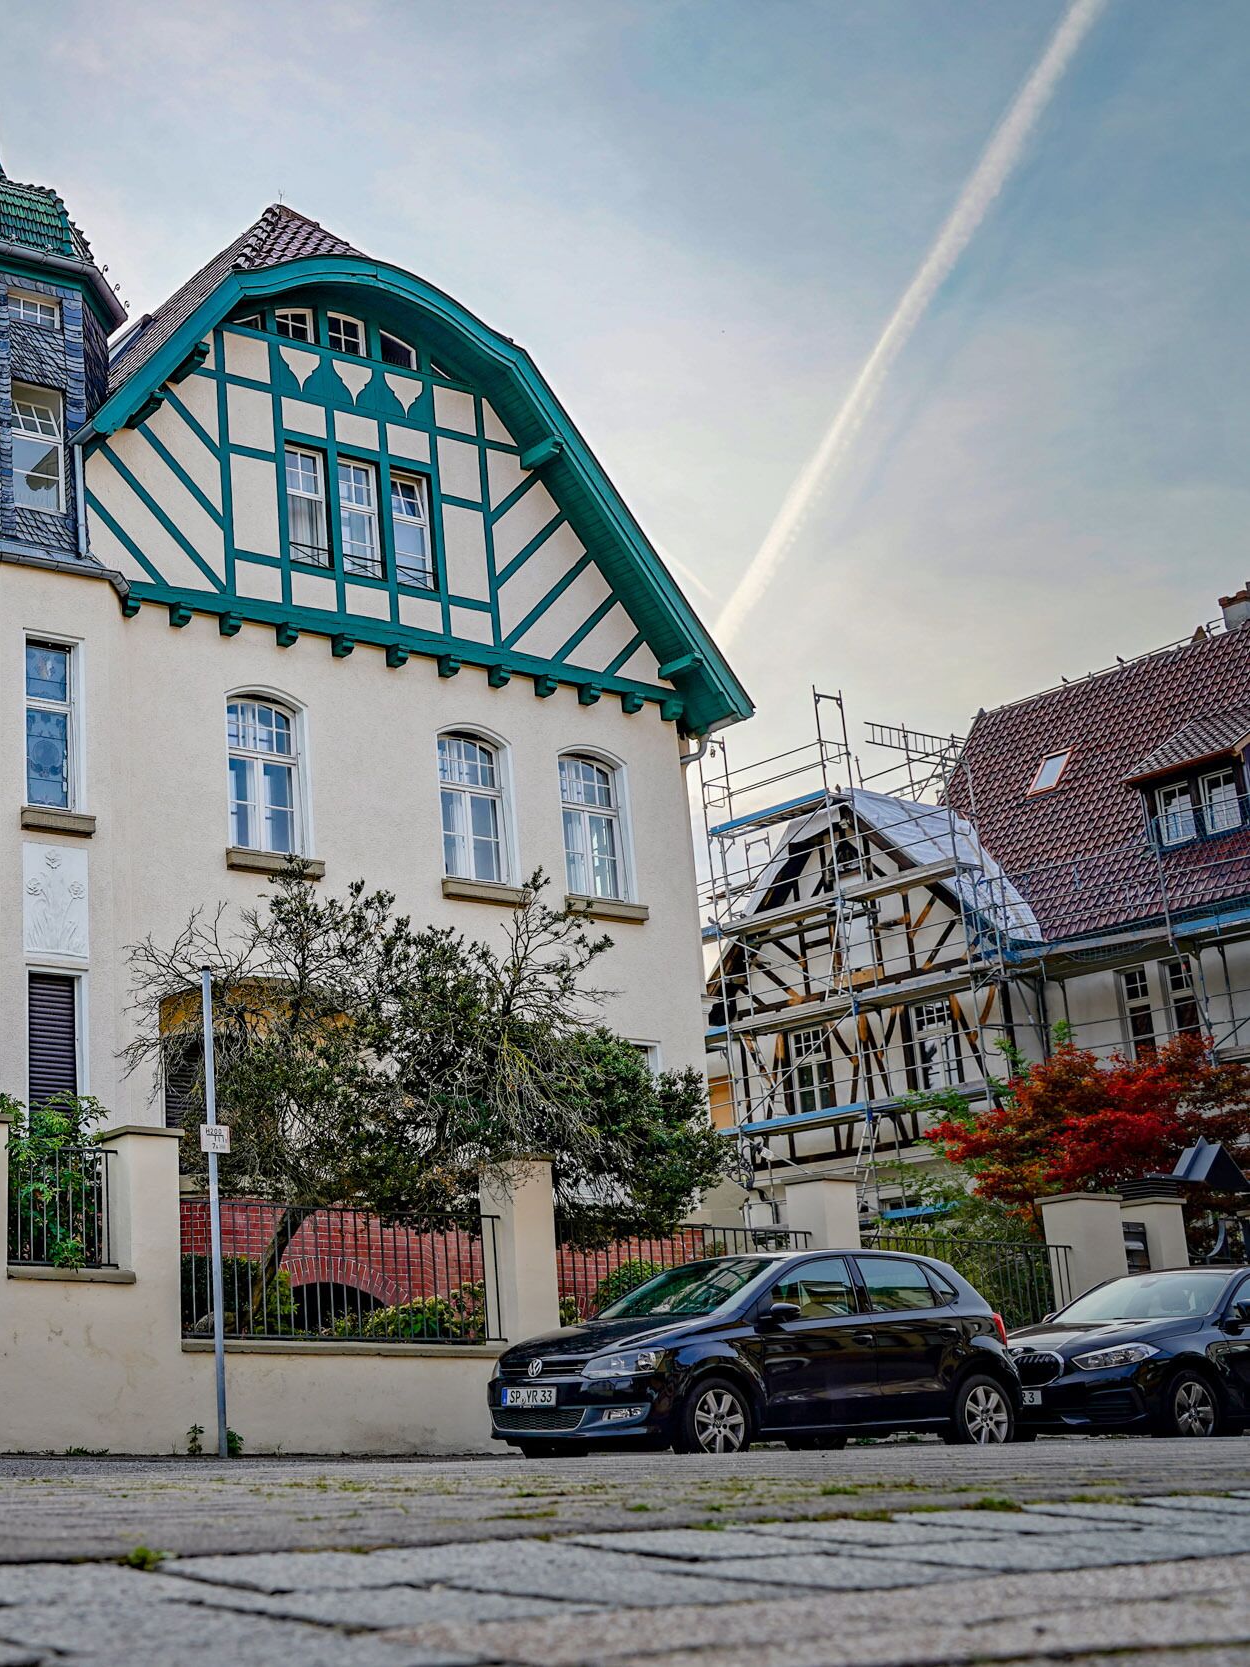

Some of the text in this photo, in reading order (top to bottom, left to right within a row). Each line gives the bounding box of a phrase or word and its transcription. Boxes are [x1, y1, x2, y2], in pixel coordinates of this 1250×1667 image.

[509, 1389, 553, 1404] SP YR 33
[1028, 1391, 1035, 1404] 3
